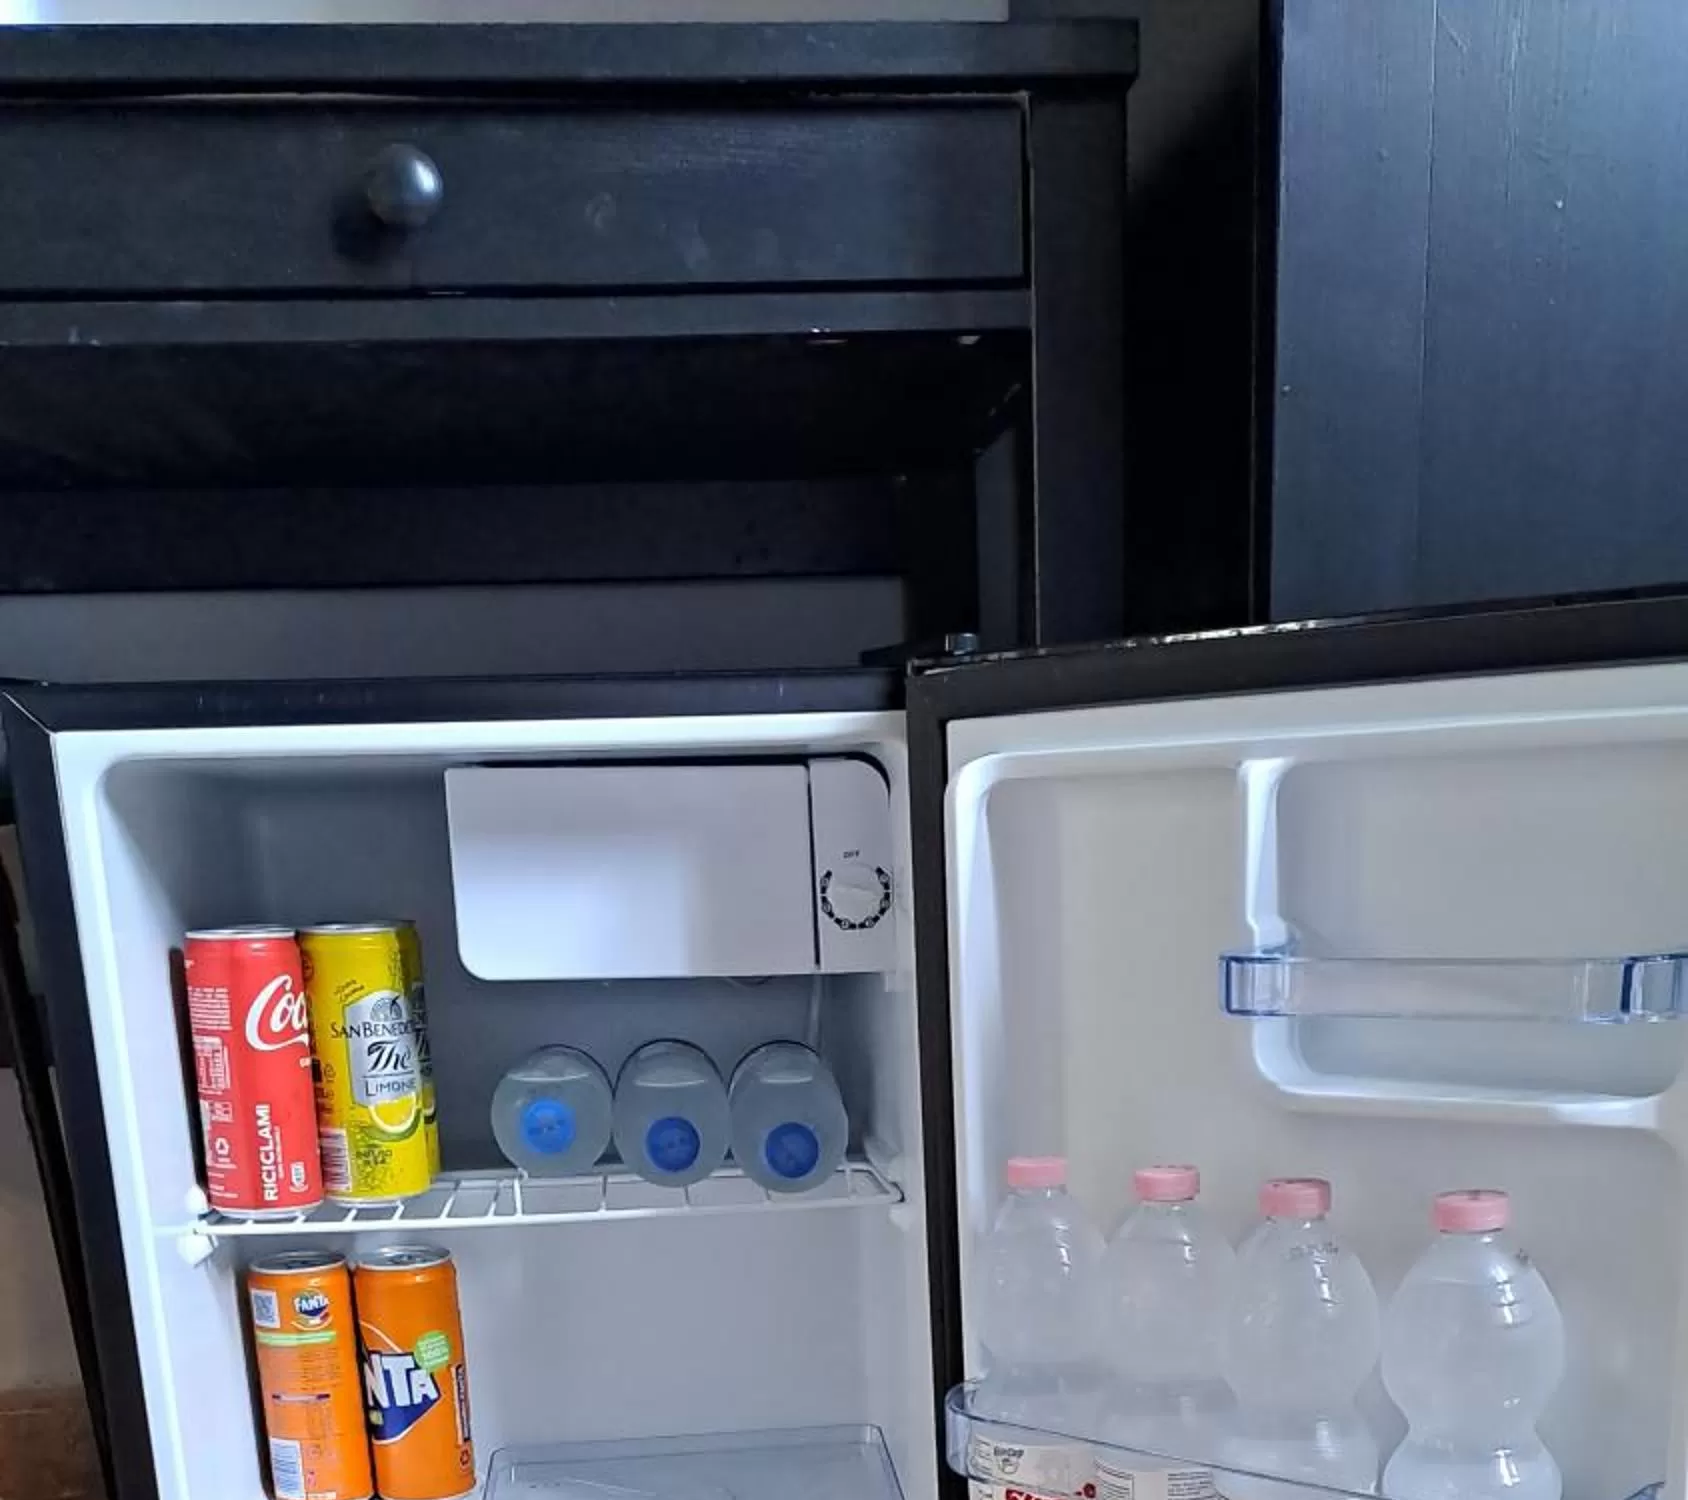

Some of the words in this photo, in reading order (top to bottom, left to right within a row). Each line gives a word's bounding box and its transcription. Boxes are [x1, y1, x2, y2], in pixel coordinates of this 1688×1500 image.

[365, 1080, 417, 1097] LIMONE
[255, 1104, 279, 1201] RICICLAMI
[294, 1295, 330, 1314] FANTA
